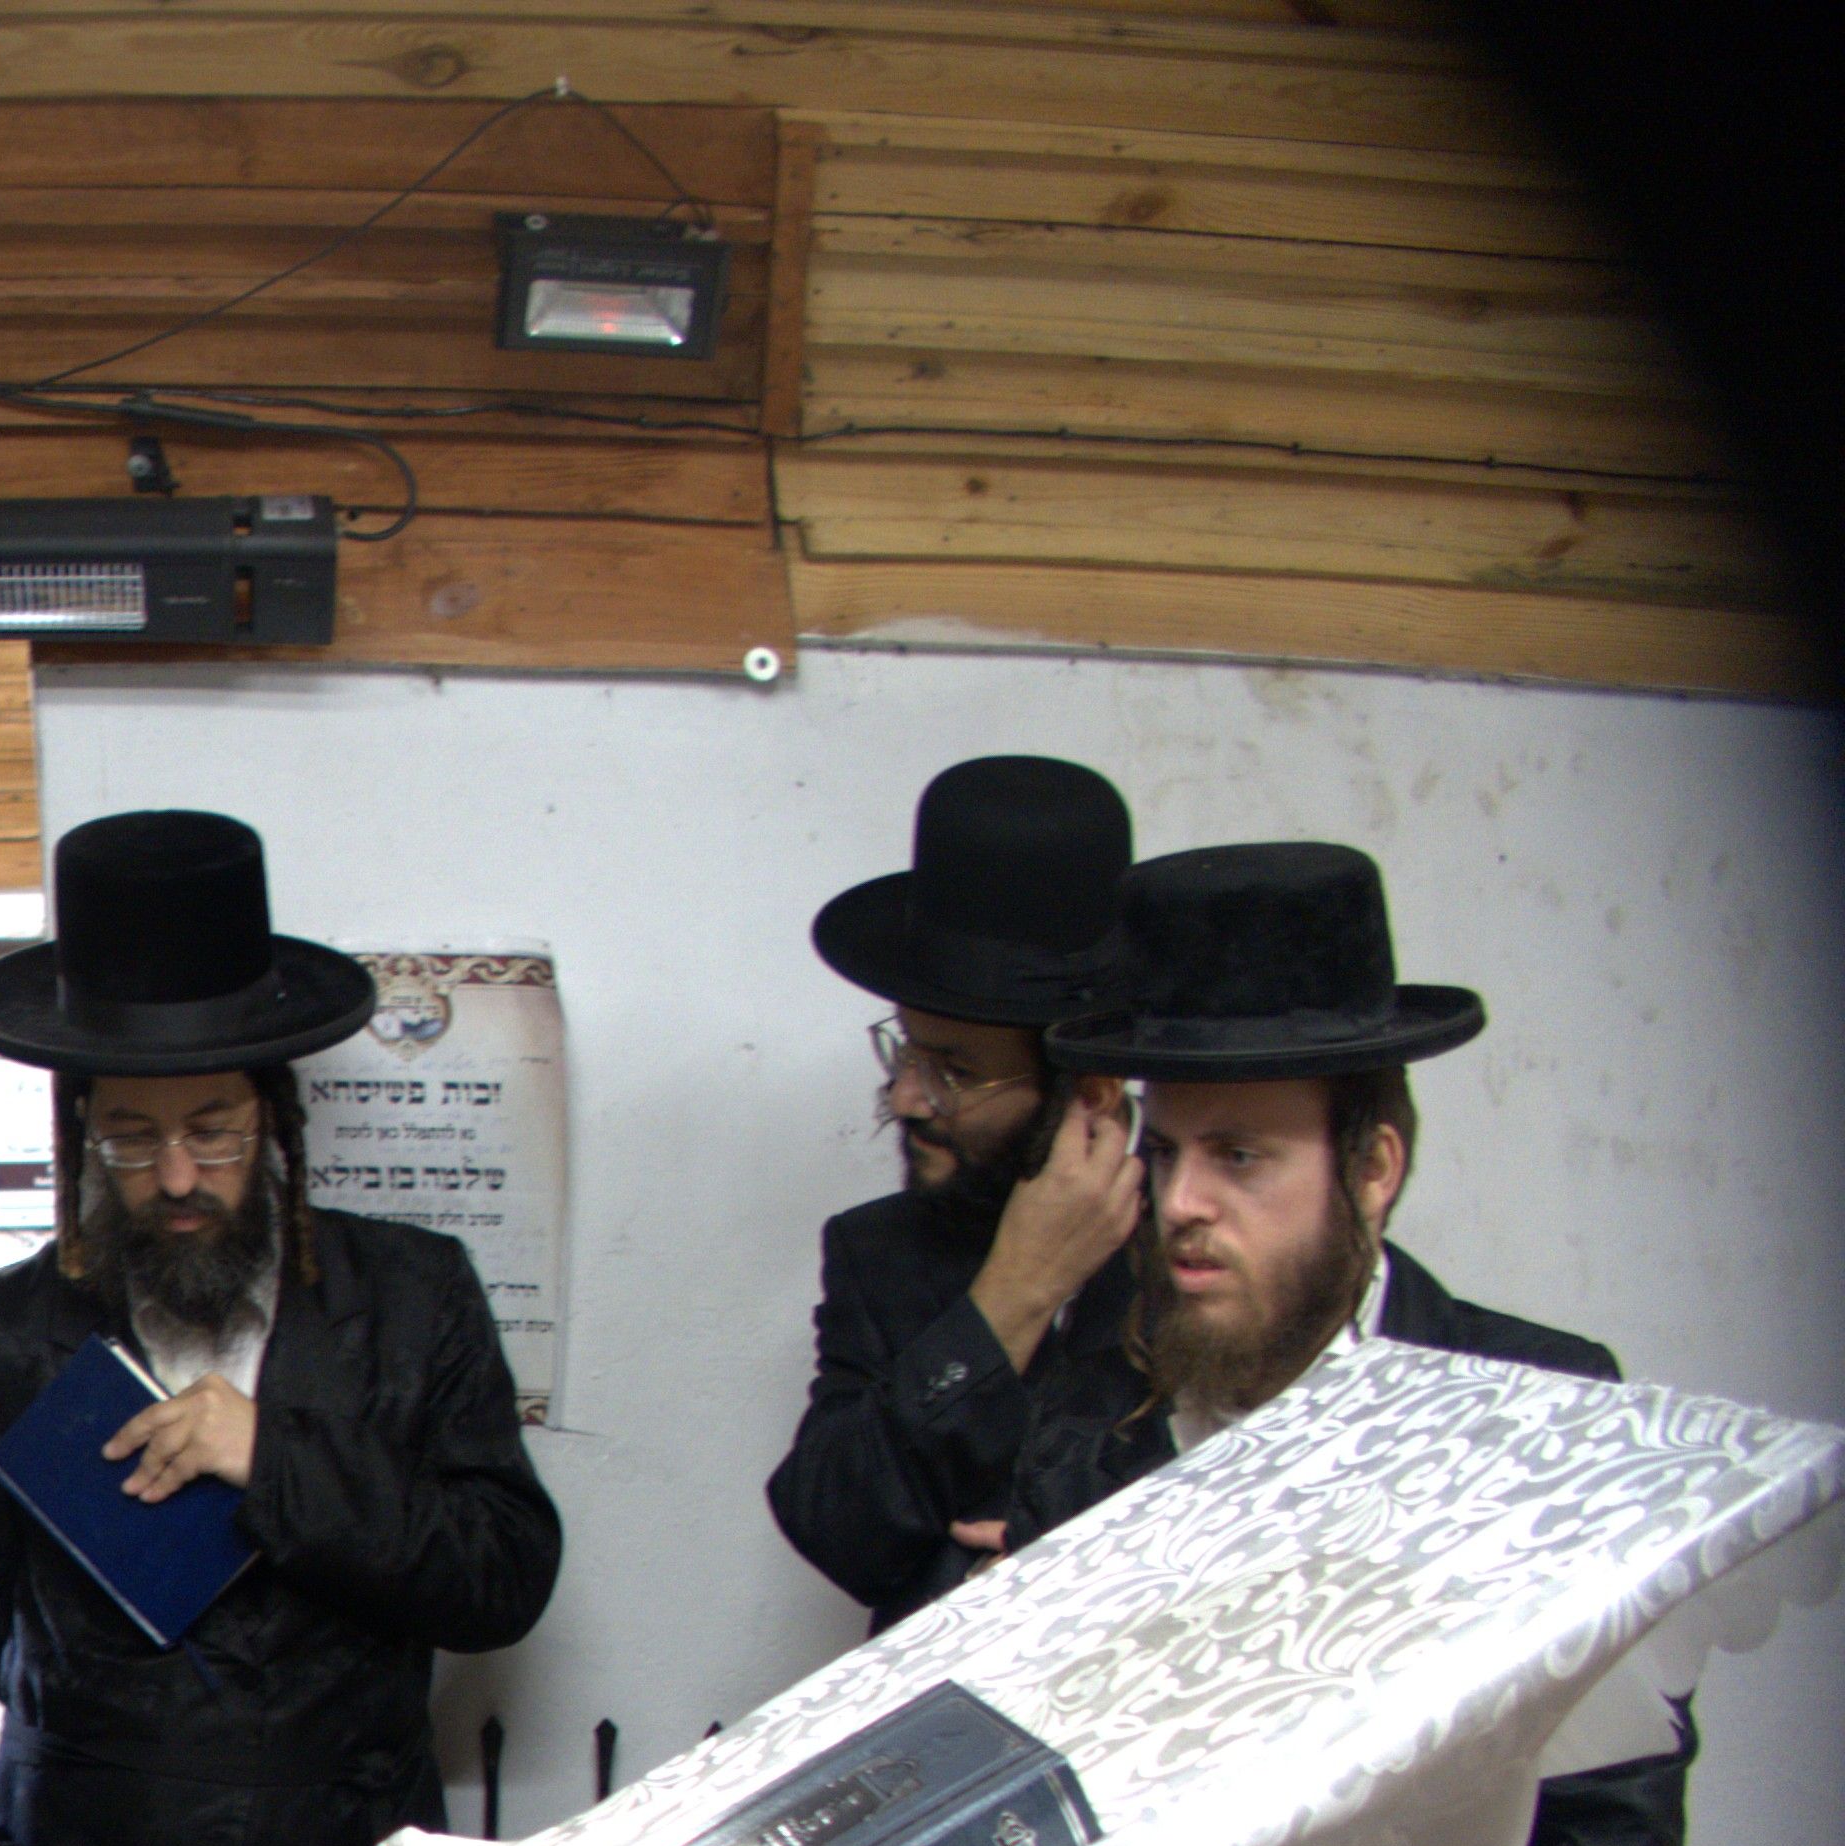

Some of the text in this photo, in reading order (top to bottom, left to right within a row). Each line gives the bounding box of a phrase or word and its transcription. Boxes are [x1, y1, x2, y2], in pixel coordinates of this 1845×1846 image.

[310, 1080, 502, 1105] זכות פשיסחא
[422, 1155, 506, 1191] שלמה
